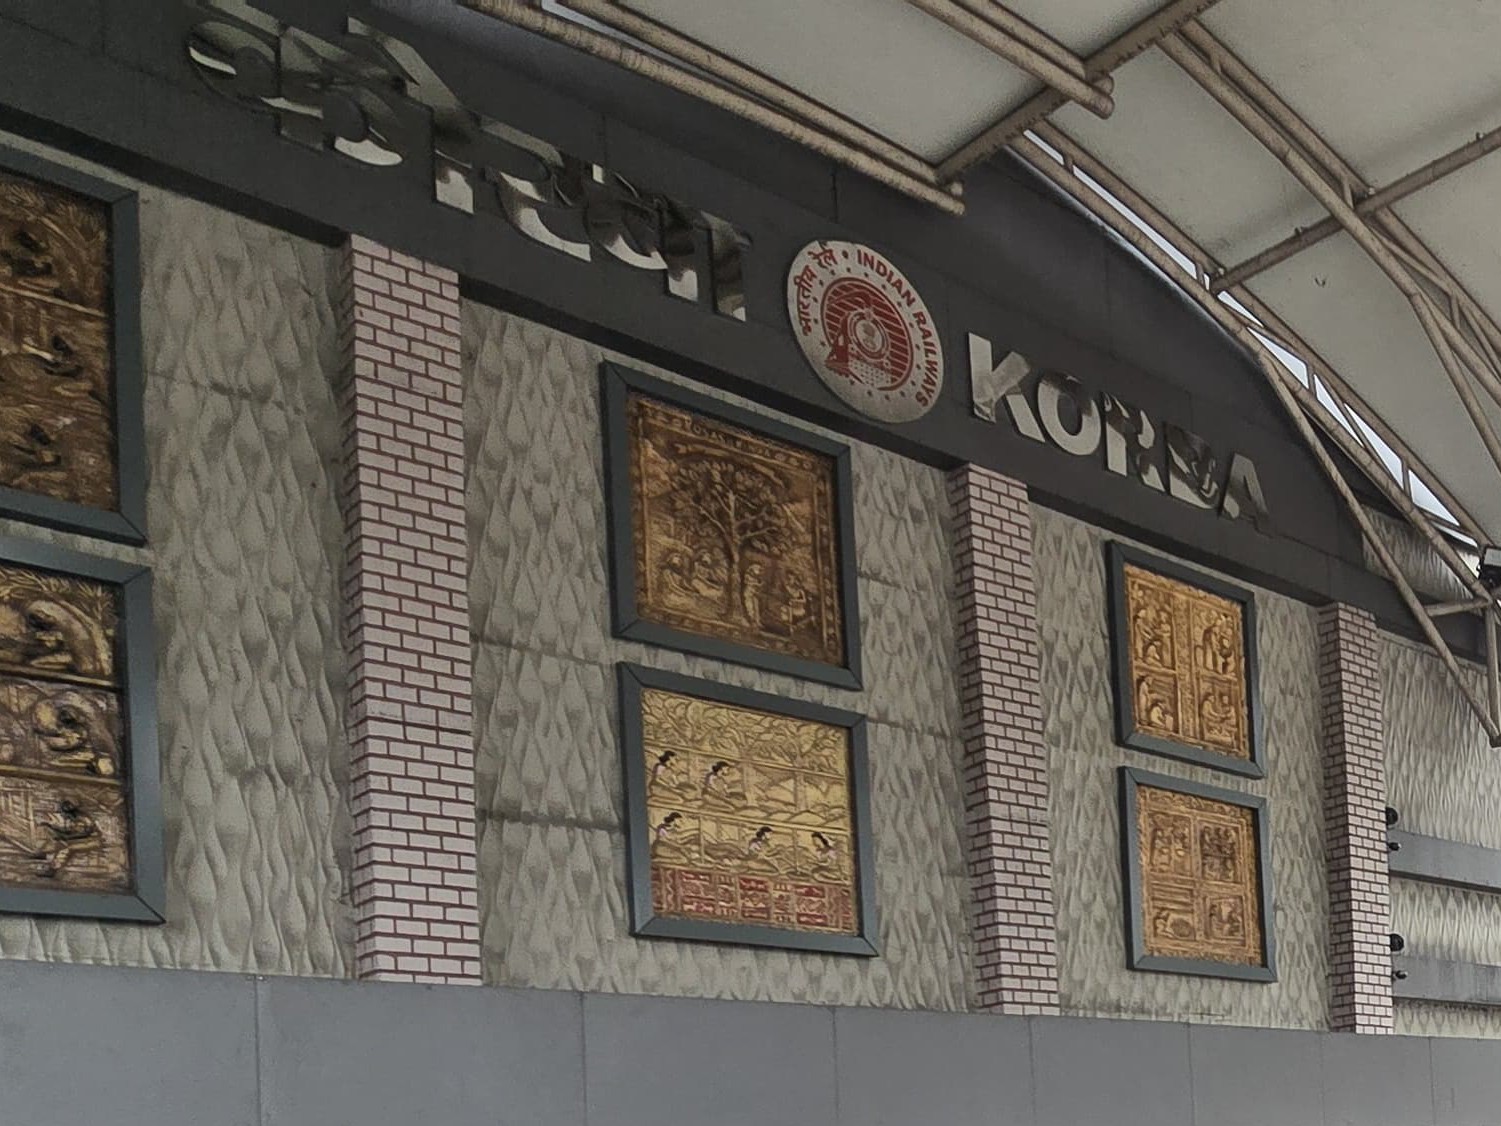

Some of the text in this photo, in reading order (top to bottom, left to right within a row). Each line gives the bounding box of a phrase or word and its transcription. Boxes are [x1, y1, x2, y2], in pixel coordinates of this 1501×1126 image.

[793, 264, 818, 336] भारतीय
[856, 249, 939, 408] INDIAN RAILWAYS
[967, 332, 1270, 520] KORBA
